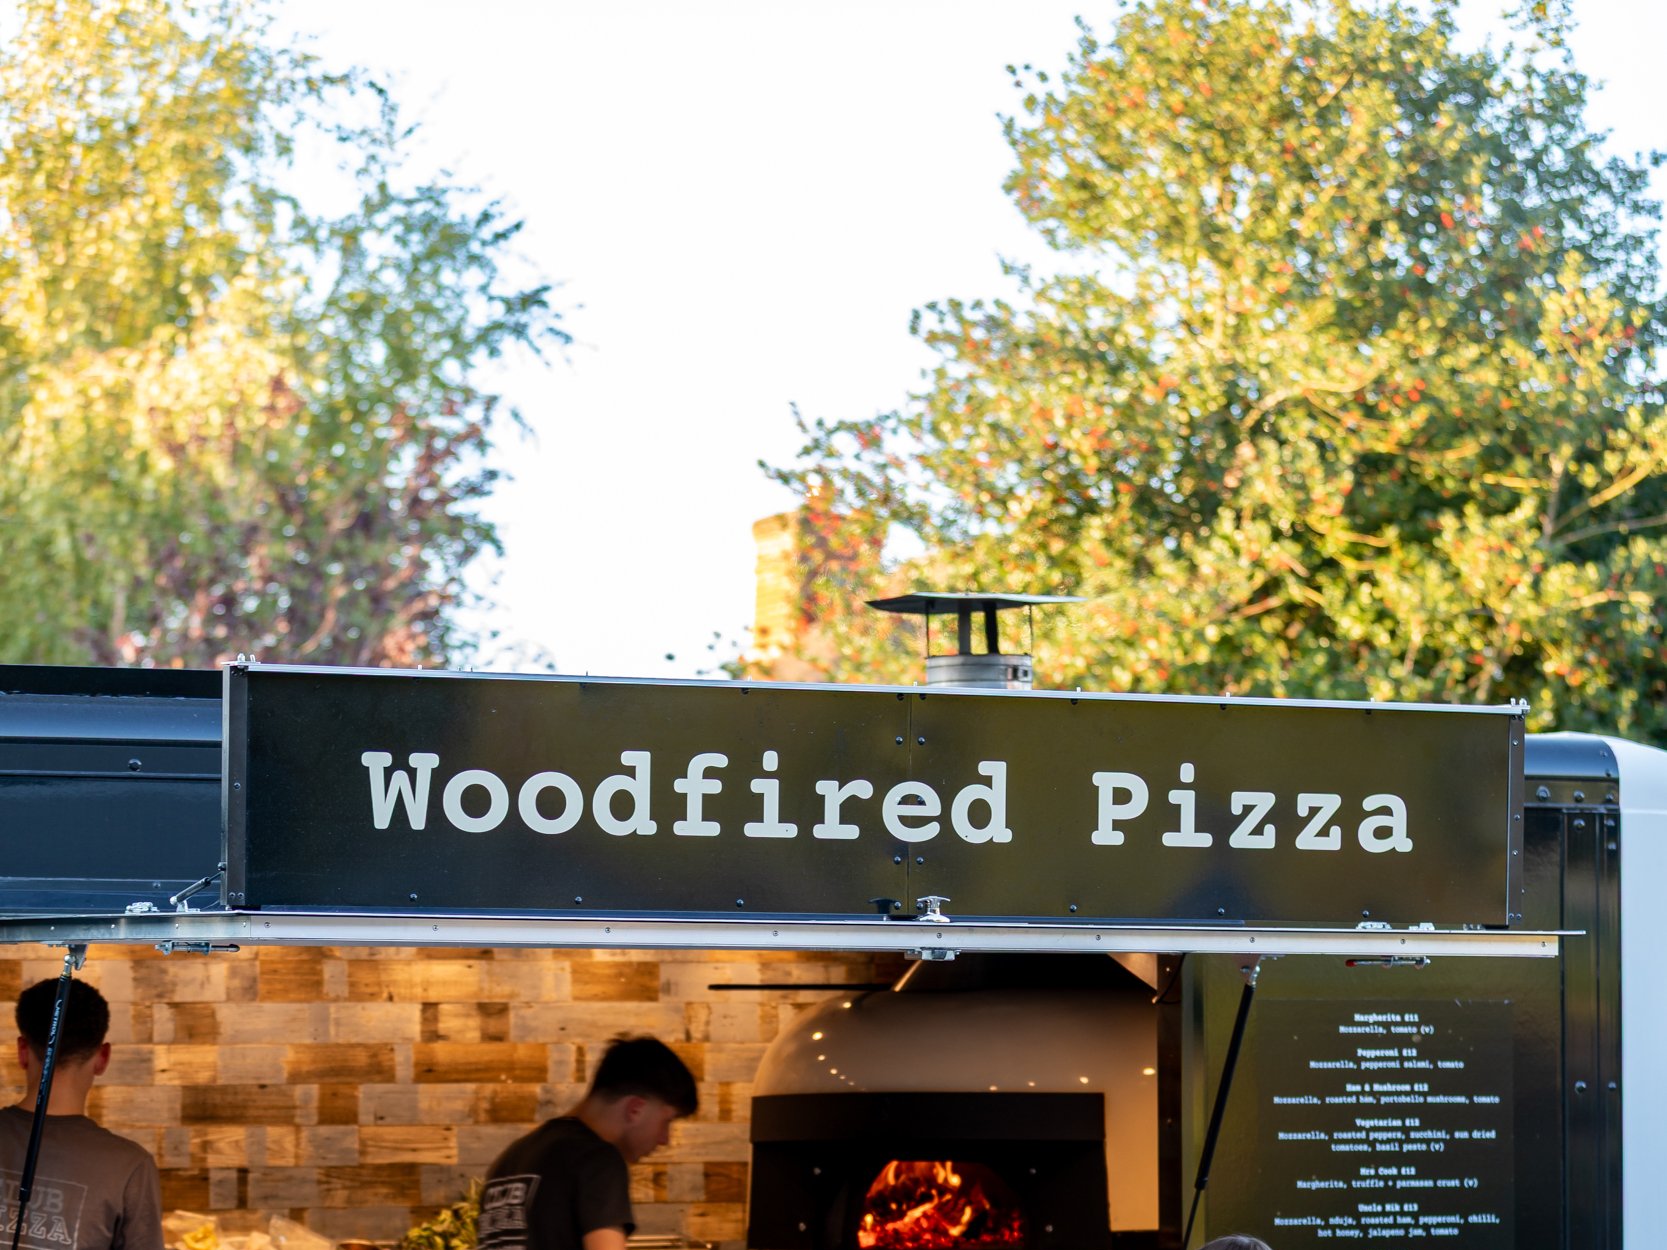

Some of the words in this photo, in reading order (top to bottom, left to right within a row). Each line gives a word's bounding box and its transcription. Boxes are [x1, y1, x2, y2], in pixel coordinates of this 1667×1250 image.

[362, 751, 1012, 844] Woodfired
[1092, 762, 1412, 853] Pizza
[1353, 1013, 1401, 1023] Margherita
[1338, 1025, 1387, 1035] Mozzarella,
[1356, 1048, 1399, 1058] Pepperoni
[1308, 1060, 1357, 1069] Mozzarella,
[1359, 1060, 1401, 1070] pepperoni
[1402, 1059, 1434, 1069] salami,
[1436, 1060, 1464, 1069] tomato
[1345, 1083, 1362, 1092] Ham
[1372, 1083, 1411, 1091] Mushroom
[1272, 1095, 1321, 1104] Mozzarella,
[1324, 1095, 1357, 1104] roasted
[1358, 1095, 1376, 1104] ham,
[1379, 1094, 1425, 1104] portobello
[1425, 1095, 1470, 1104] mushrooms,
[1472, 1095, 1500, 1104] tomato
[1354, 1117, 1402, 1128] Vegetarian
[1277, 1130, 1329, 1140] Mozzarella,
[1332, 1131, 1366, 1139] roasted
[1368, 1132, 1405, 1140] peppers,
[1409, 1130, 1450, 1139] zucchini,
[1453, 1131, 1470, 1139] sun
[1471, 1129, 1496, 1139] dried
[1330, 1143, 1372, 1152] tomatoes,
[1375, 1142, 1400, 1151] basil
[1401, 1143, 1427, 1152] pesto
[1295, 1179, 1347, 1190] Margherita,
[1350, 1179, 1385, 1188] truffle
[1435, 1179, 1461, 1187] crust
[1357, 1203, 1383, 1212] Uncle
[1273, 1216, 1325, 1226] Mozzarella,
[1360, 1216, 1393, 1224] roasted
[1396, 1216, 1414, 1224] ham,
[1418, 1214, 1464, 1225] pepperoni,
[1466, 1213, 1500, 1224] chilli,
[1316, 1228, 1333, 1237] hot
[1334, 1228, 1363, 1238] honey,
[1367, 1228, 1405, 1238] jalapeno
[1407, 1227, 1426, 1238] jam,
[1429, 1227, 1459, 1236] tomato
